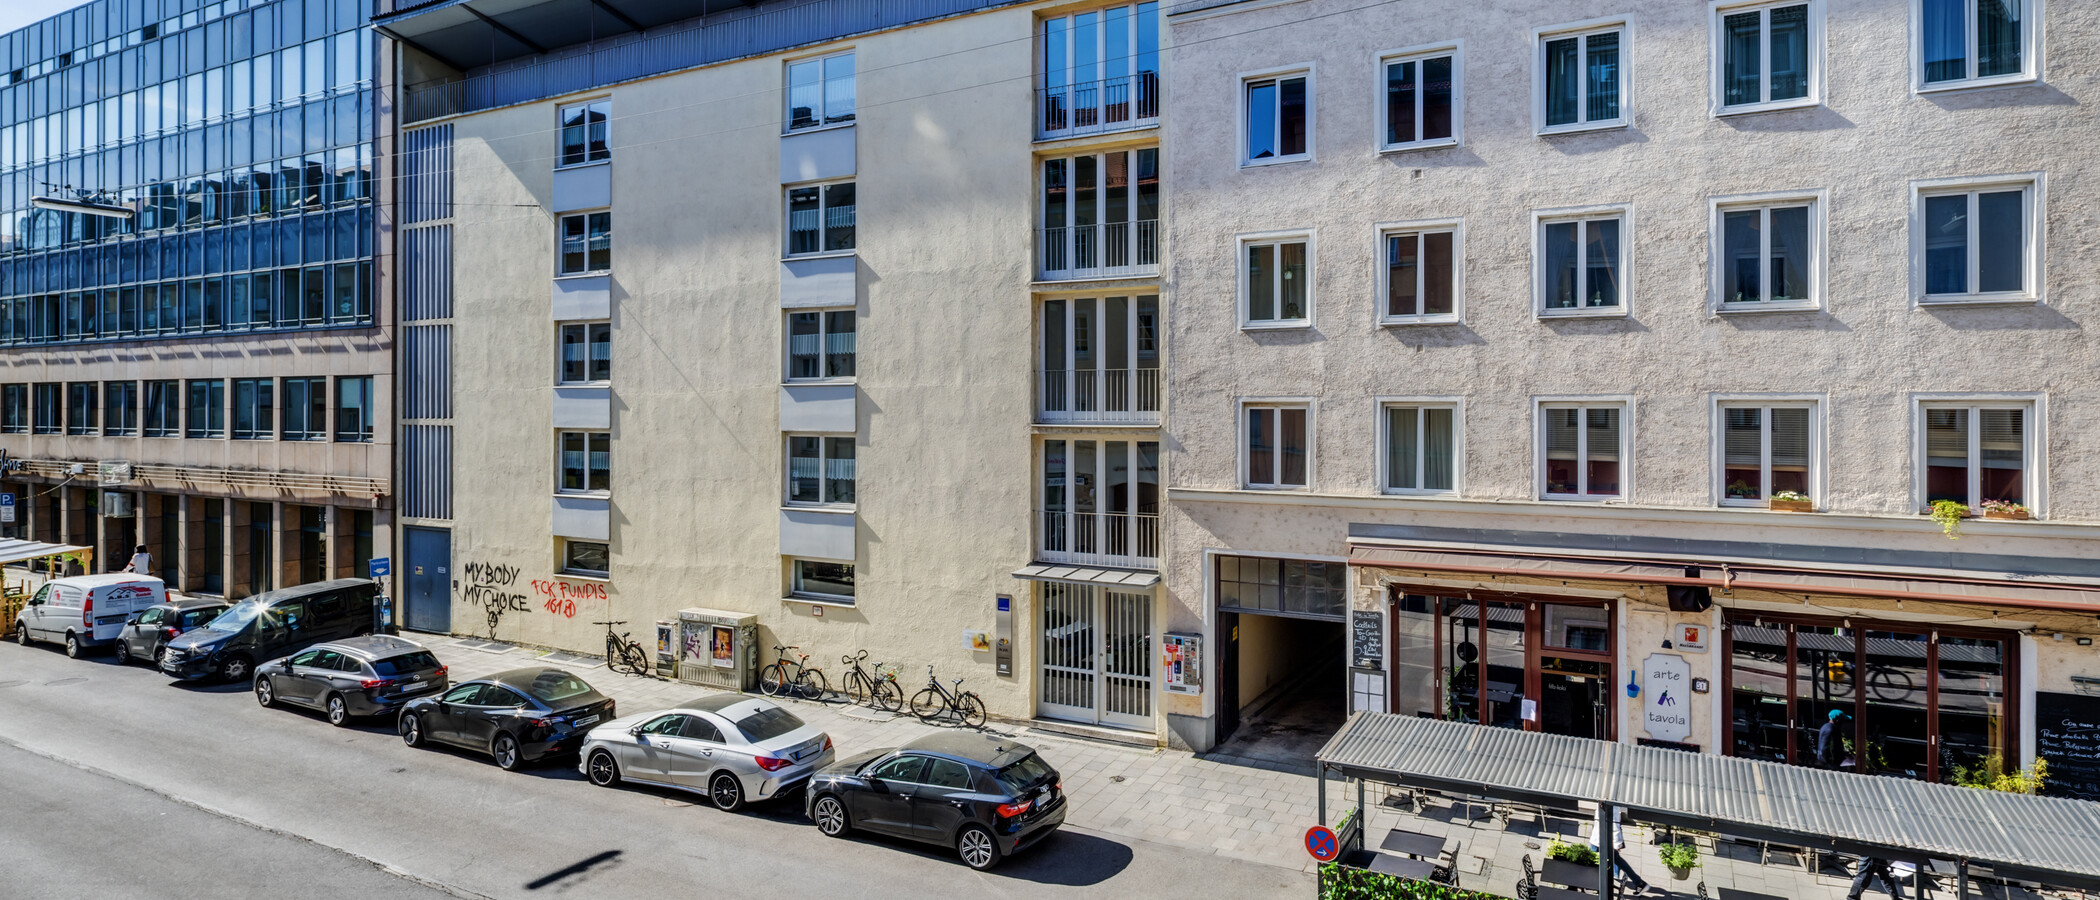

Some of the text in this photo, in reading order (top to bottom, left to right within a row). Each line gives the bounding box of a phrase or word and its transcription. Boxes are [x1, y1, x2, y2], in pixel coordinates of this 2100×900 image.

[2, 494, 10, 504] P
[464, 561, 521, 587] MY BODY
[463, 583, 482, 606] MY
[531, 579, 608, 600] FCK FUNDIS
[1653, 670, 1680, 681] arte
[1649, 711, 1686, 725] tavola
